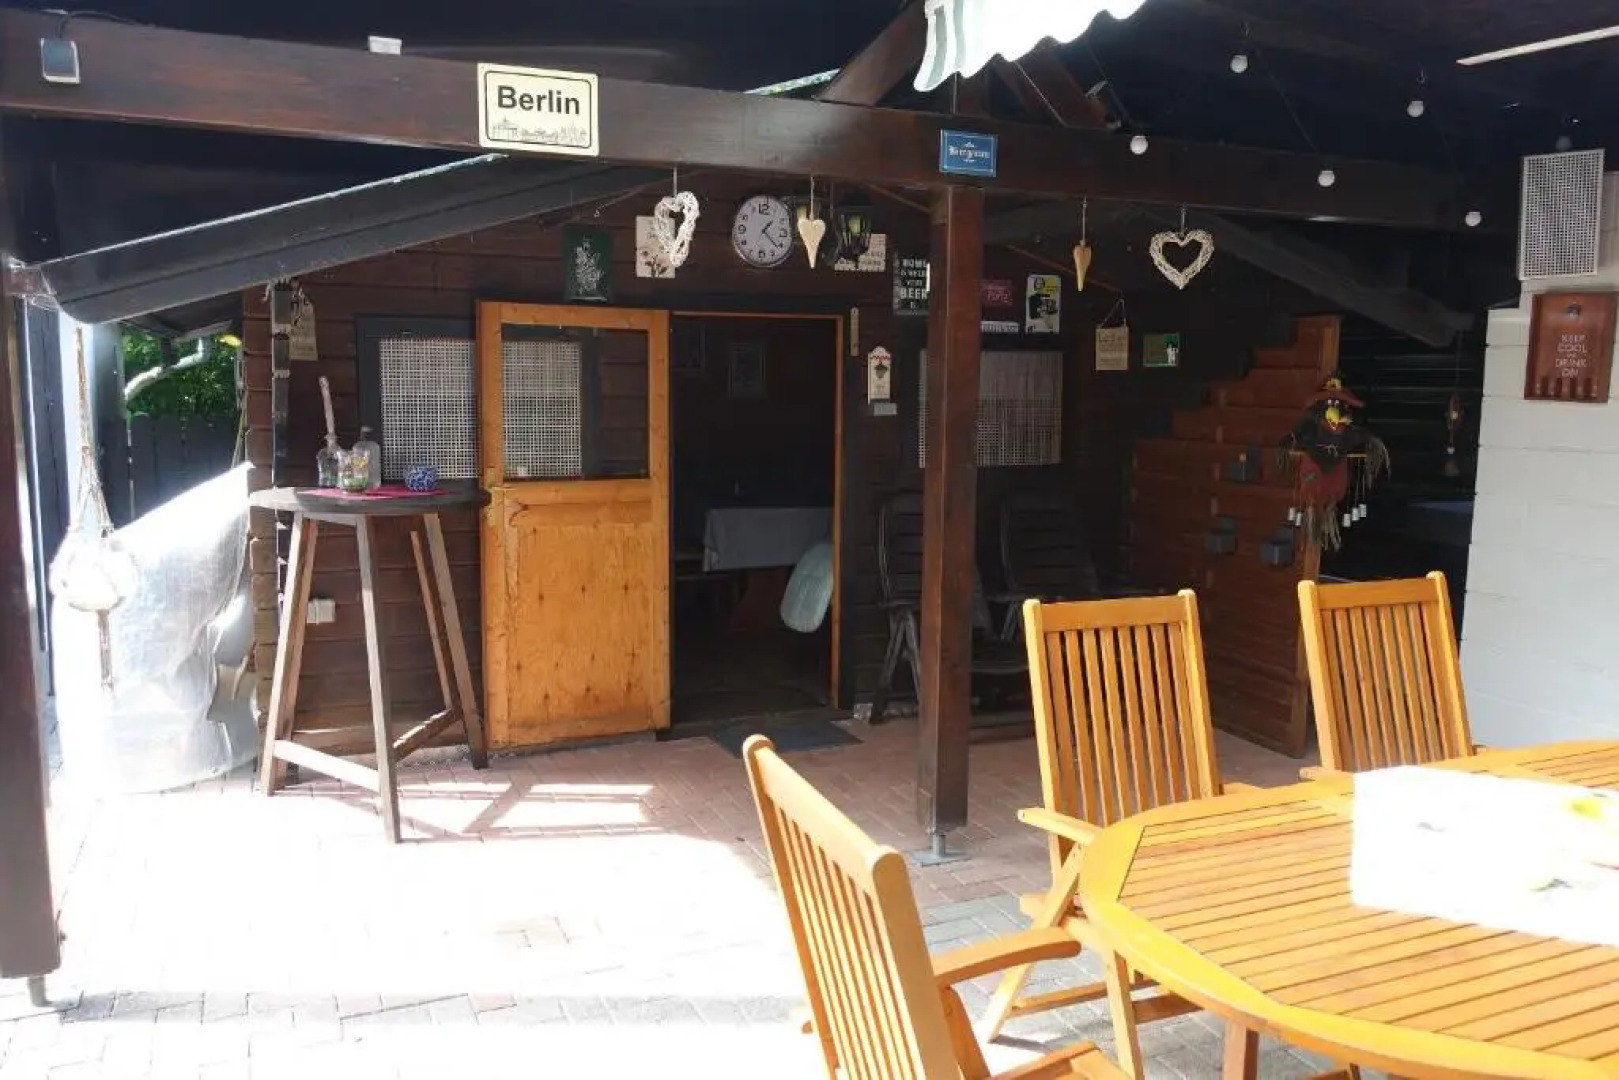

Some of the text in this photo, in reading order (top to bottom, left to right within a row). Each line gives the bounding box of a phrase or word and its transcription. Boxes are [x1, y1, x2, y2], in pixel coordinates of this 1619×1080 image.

[497, 85, 580, 115] Berlin
[758, 203, 770, 216] 12
[899, 288, 928, 300] BEER
[1557, 344, 1588, 353] COOL
[1555, 358, 1588, 368] DRINK
